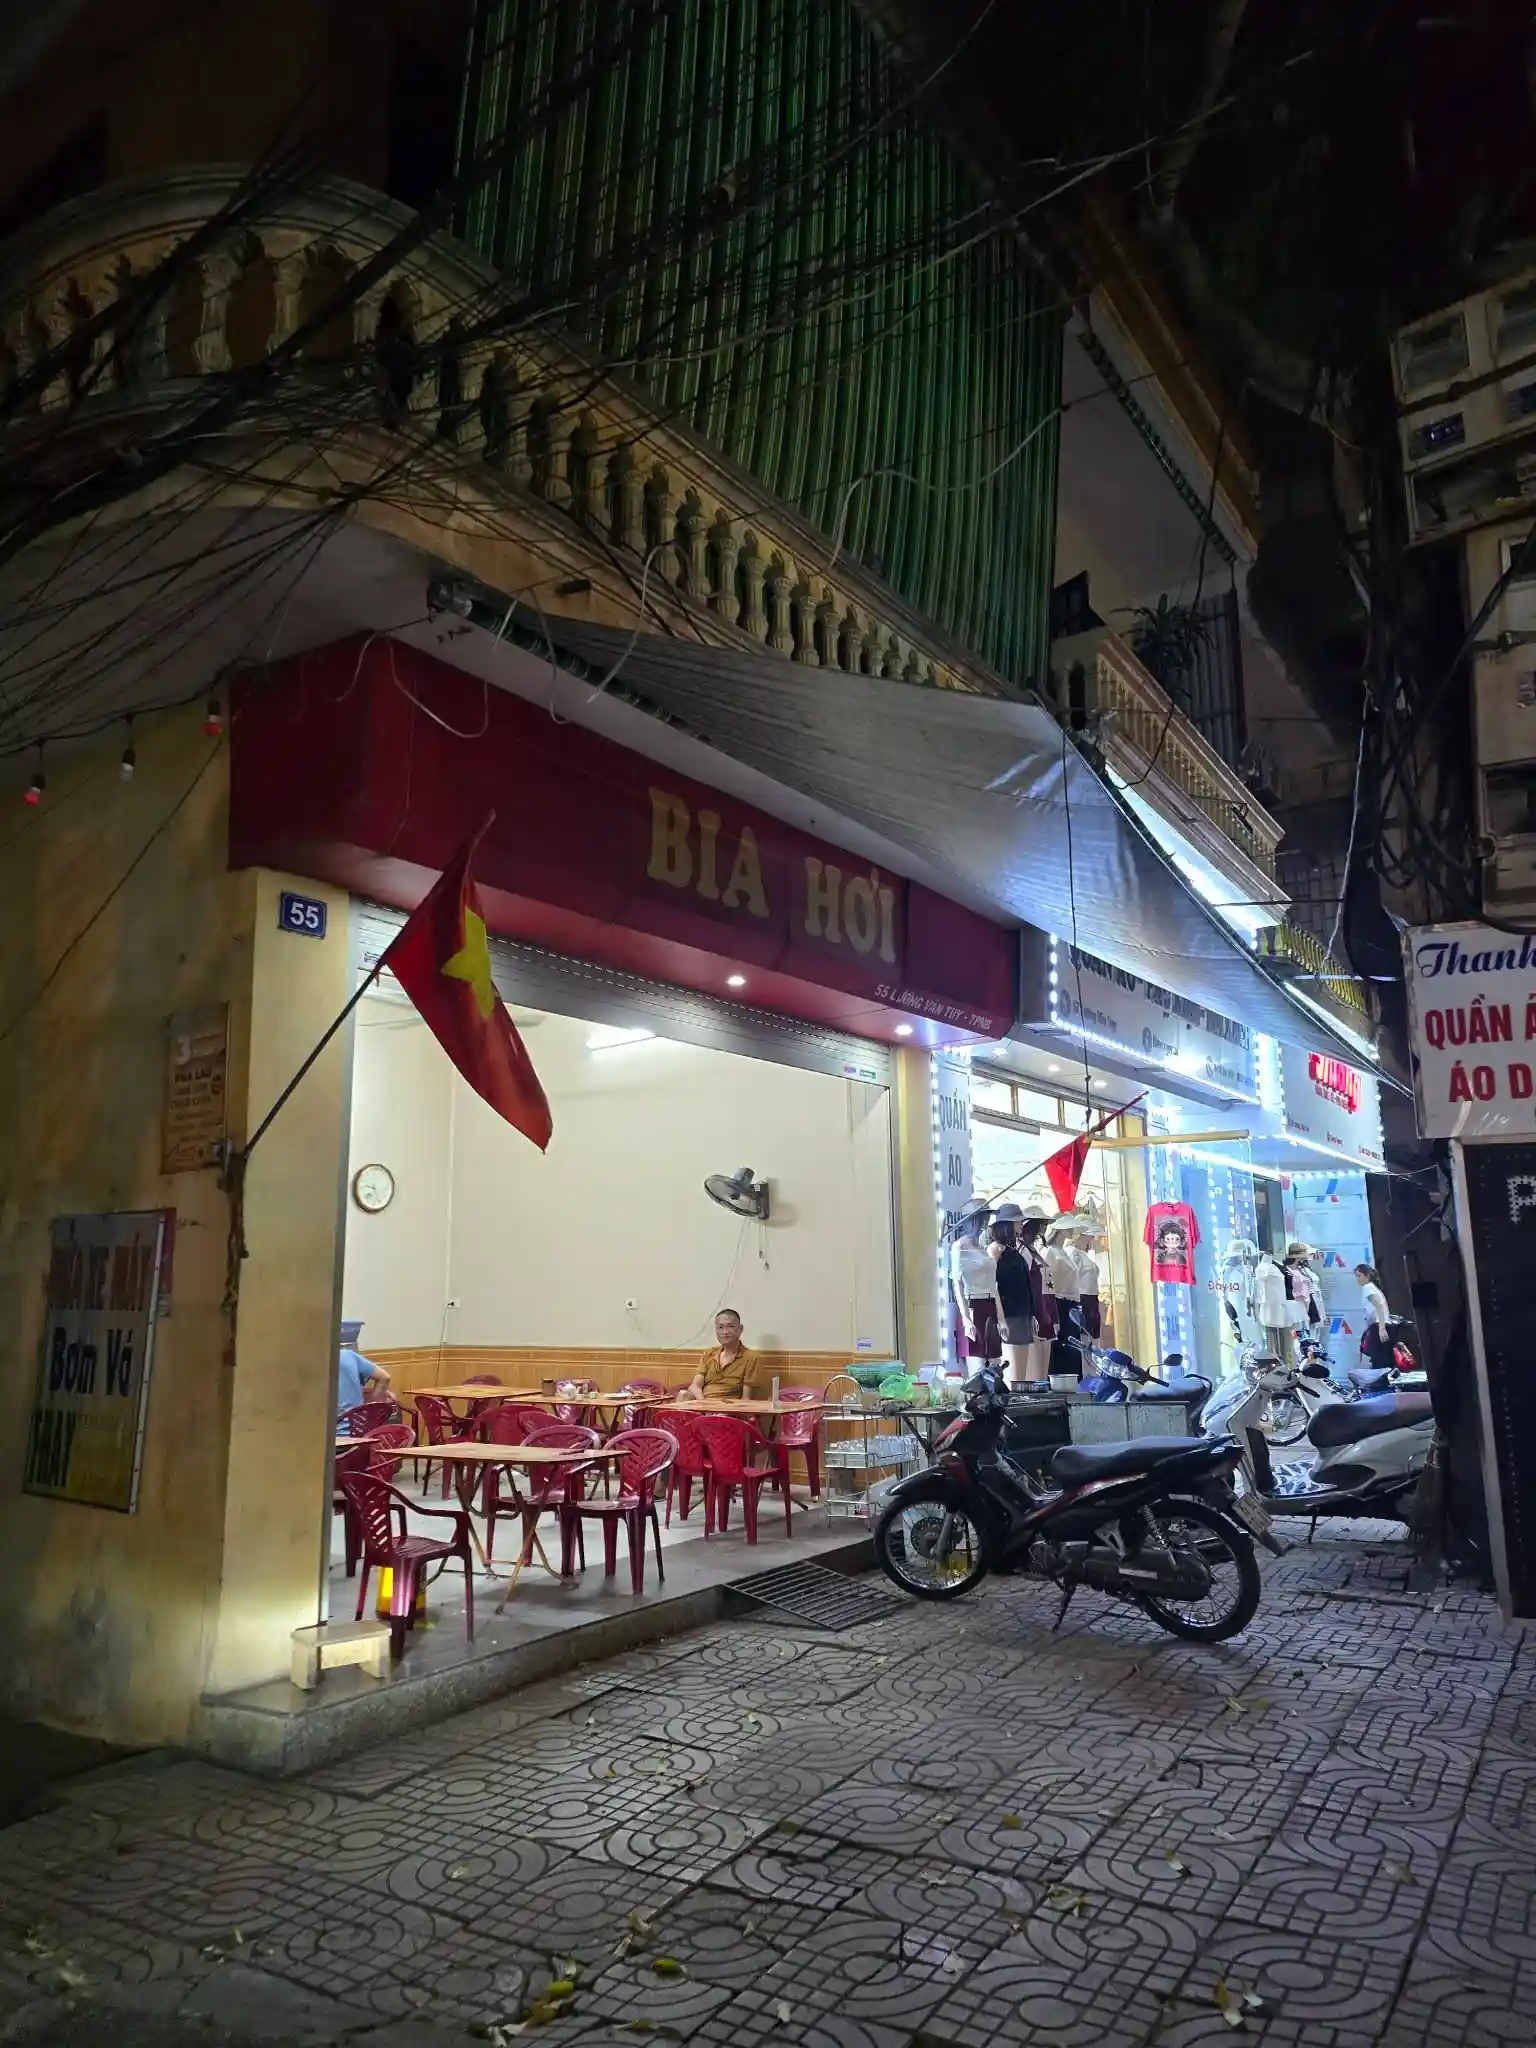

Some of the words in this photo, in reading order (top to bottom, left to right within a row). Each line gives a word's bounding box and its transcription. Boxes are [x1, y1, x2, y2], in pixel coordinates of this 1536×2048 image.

[647, 786, 770, 919] BIA
[804, 856, 897, 964] HƠI
[290, 901, 319, 929] 55
[1416, 935, 1536, 978] Thanh
[874, 984, 891, 998] 55
[1449, 1060, 1496, 1102] ÁO
